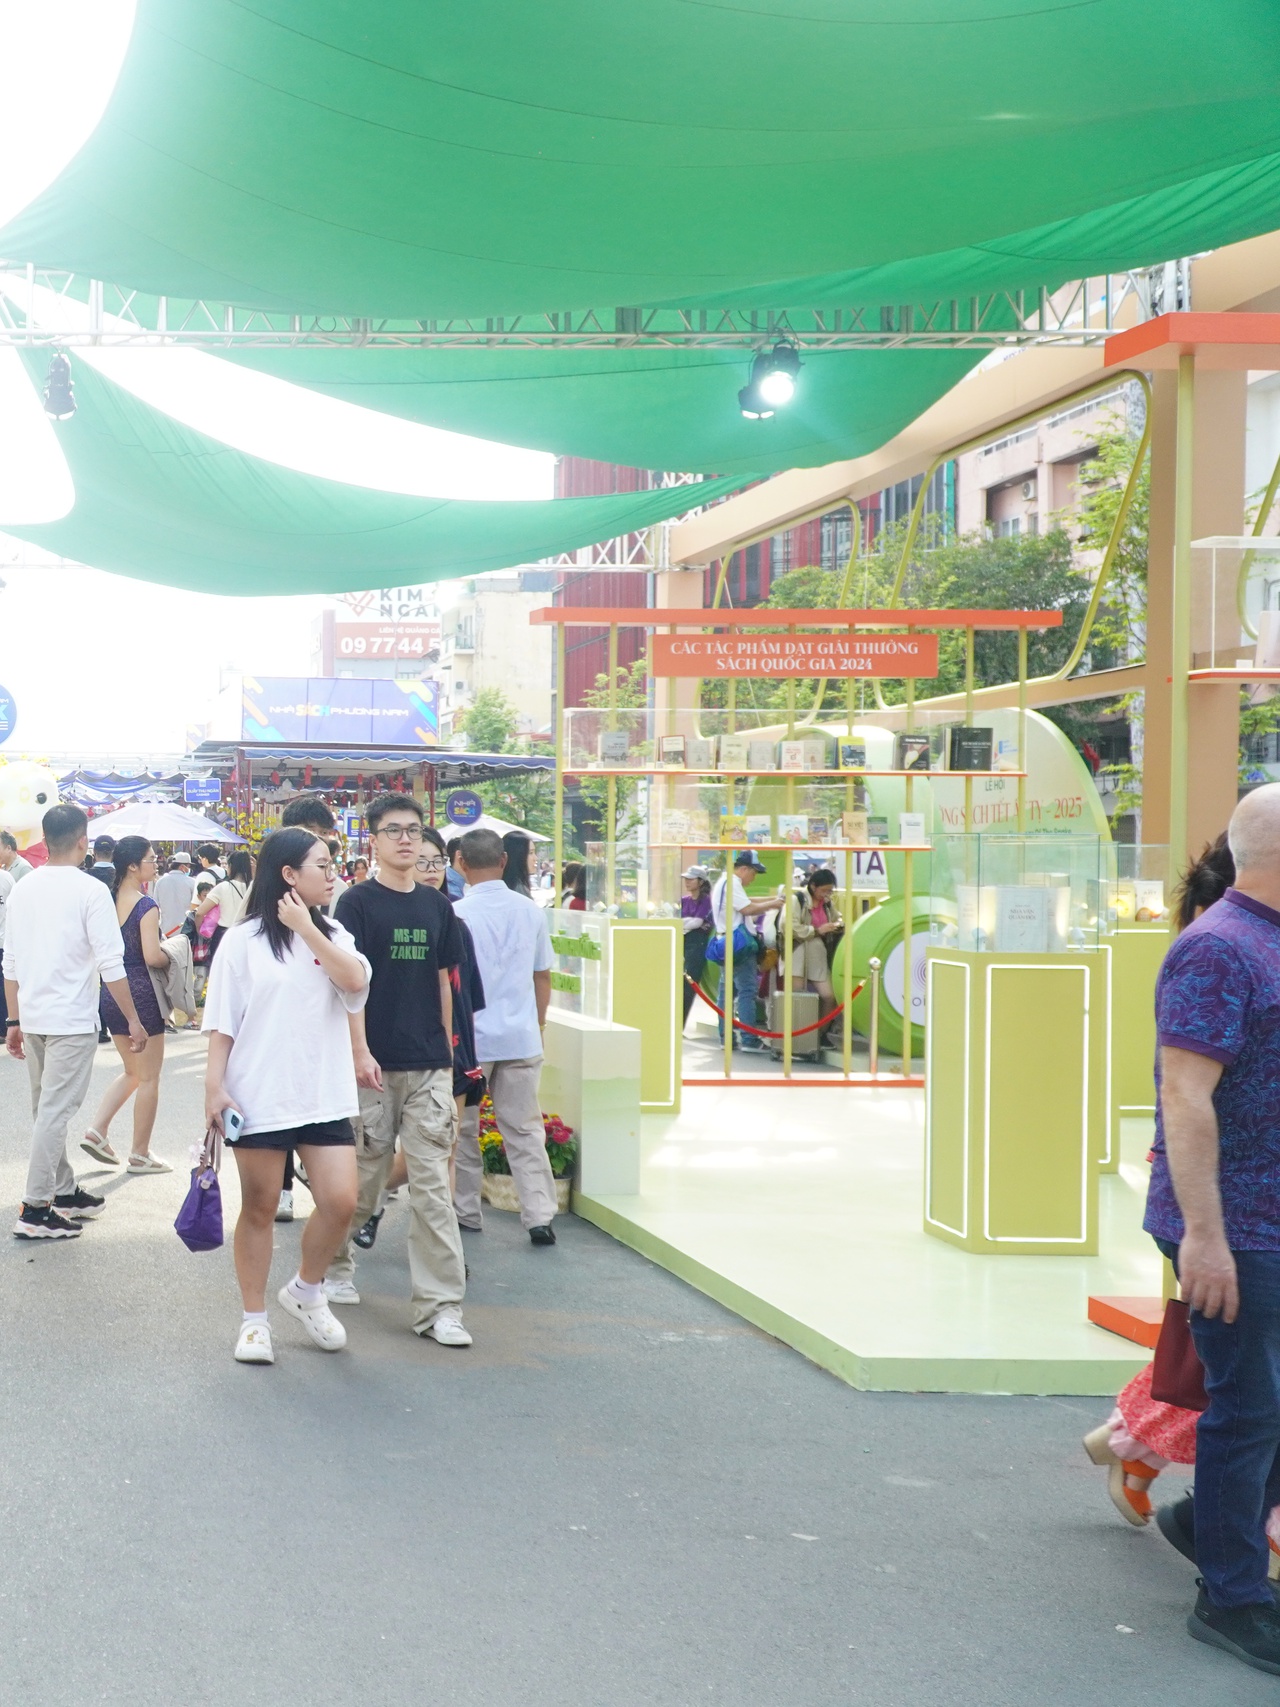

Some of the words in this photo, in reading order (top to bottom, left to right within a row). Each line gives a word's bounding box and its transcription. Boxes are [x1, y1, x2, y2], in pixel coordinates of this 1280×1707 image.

[380, 588, 423, 602] KIM
[671, 641, 702, 655] CÁC
[705, 641, 734, 655] TÁC
[737, 638, 781, 655] PHẨM
[785, 642, 814, 657] ĐẠT
[817, 640, 849, 655] GIẢI
[853, 640, 919, 655] THƯỞNG
[717, 655, 757, 671] SÁCH
[760, 653, 806, 673] QUỐC
[809, 657, 837, 671] GIA
[840, 657, 873, 671] 2024
[1054, 796, 1082, 819] 2025
[394, 928, 427, 943] MS-06
